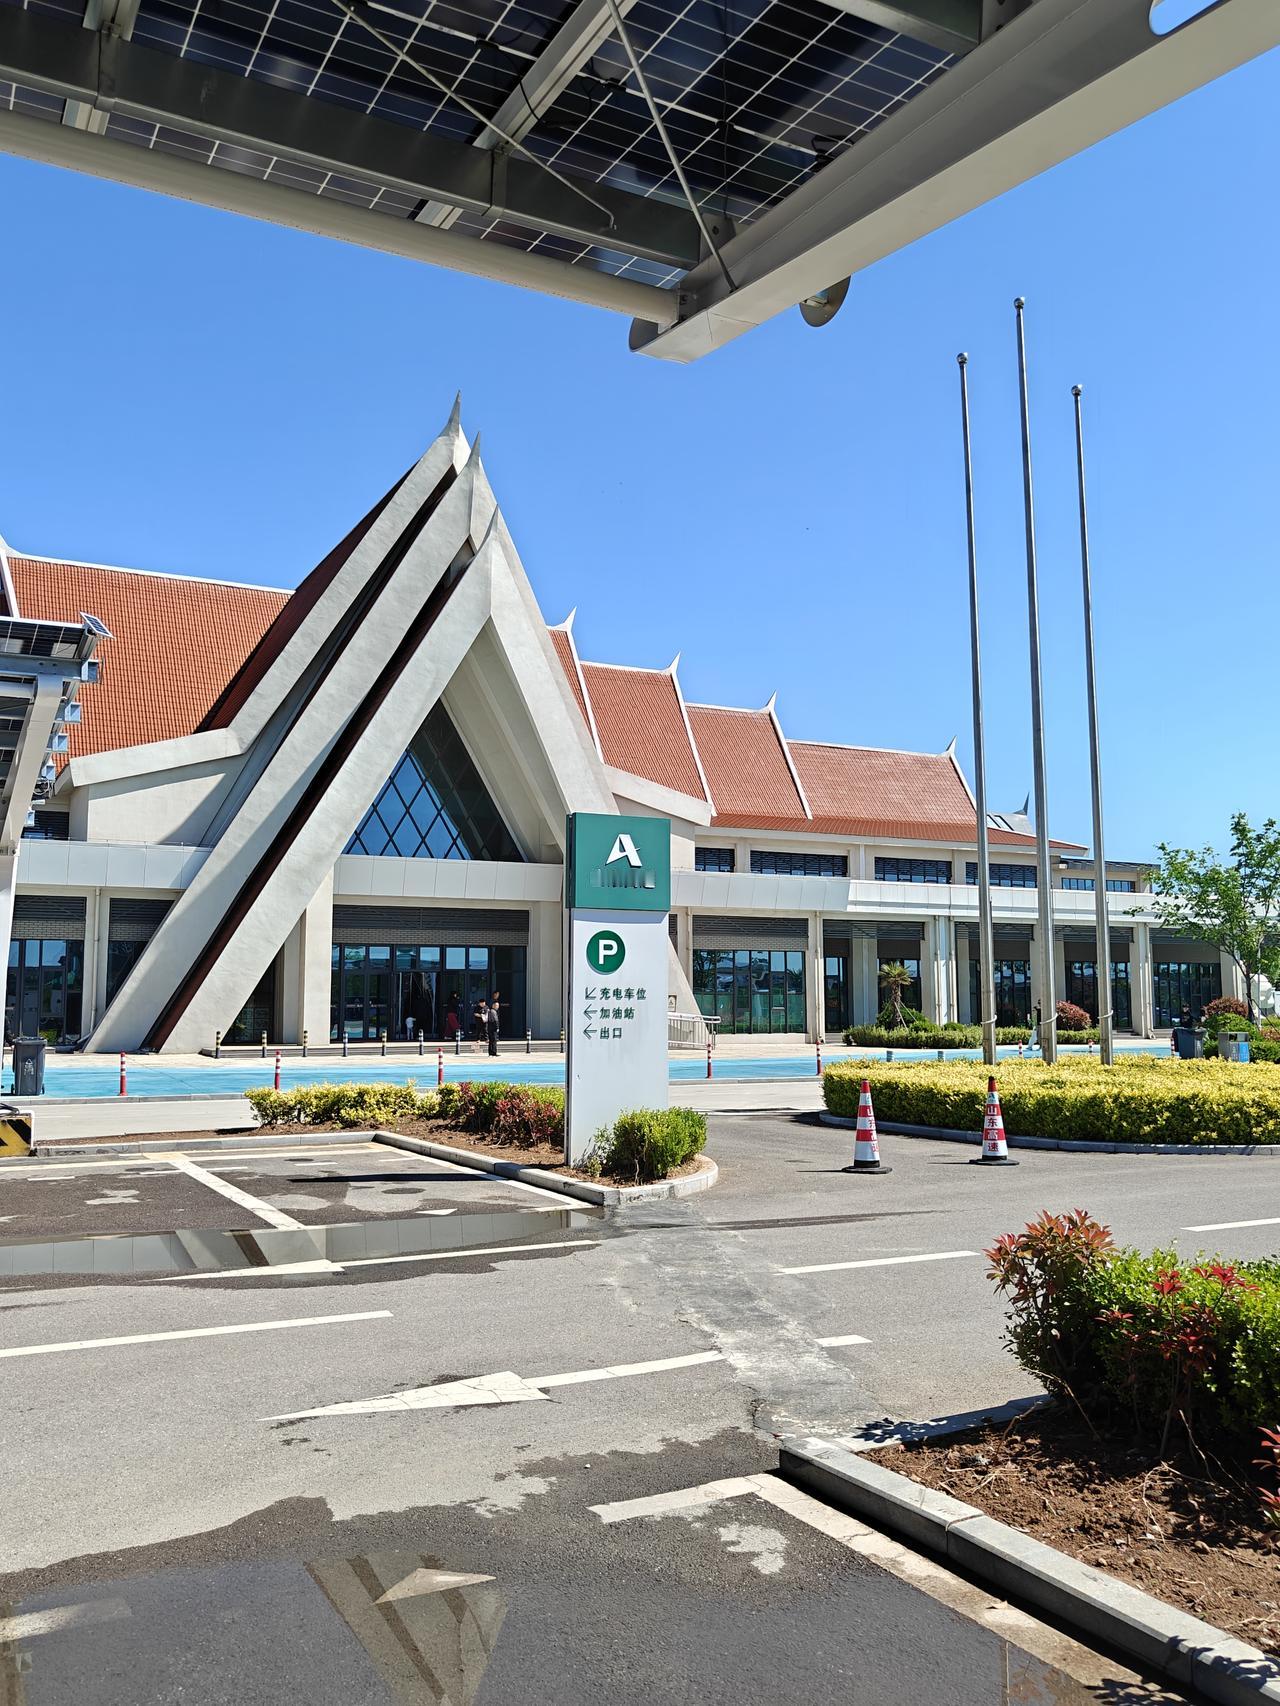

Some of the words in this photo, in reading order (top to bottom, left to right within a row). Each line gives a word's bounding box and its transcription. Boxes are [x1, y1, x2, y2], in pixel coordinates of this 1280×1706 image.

[598, 939, 618, 965] P
[600, 987, 647, 1001] 充电车位
[600, 1006, 635, 1020] 加油站
[600, 1026, 622, 1040] 出口
[987, 1106, 998, 1151] 山东高速
